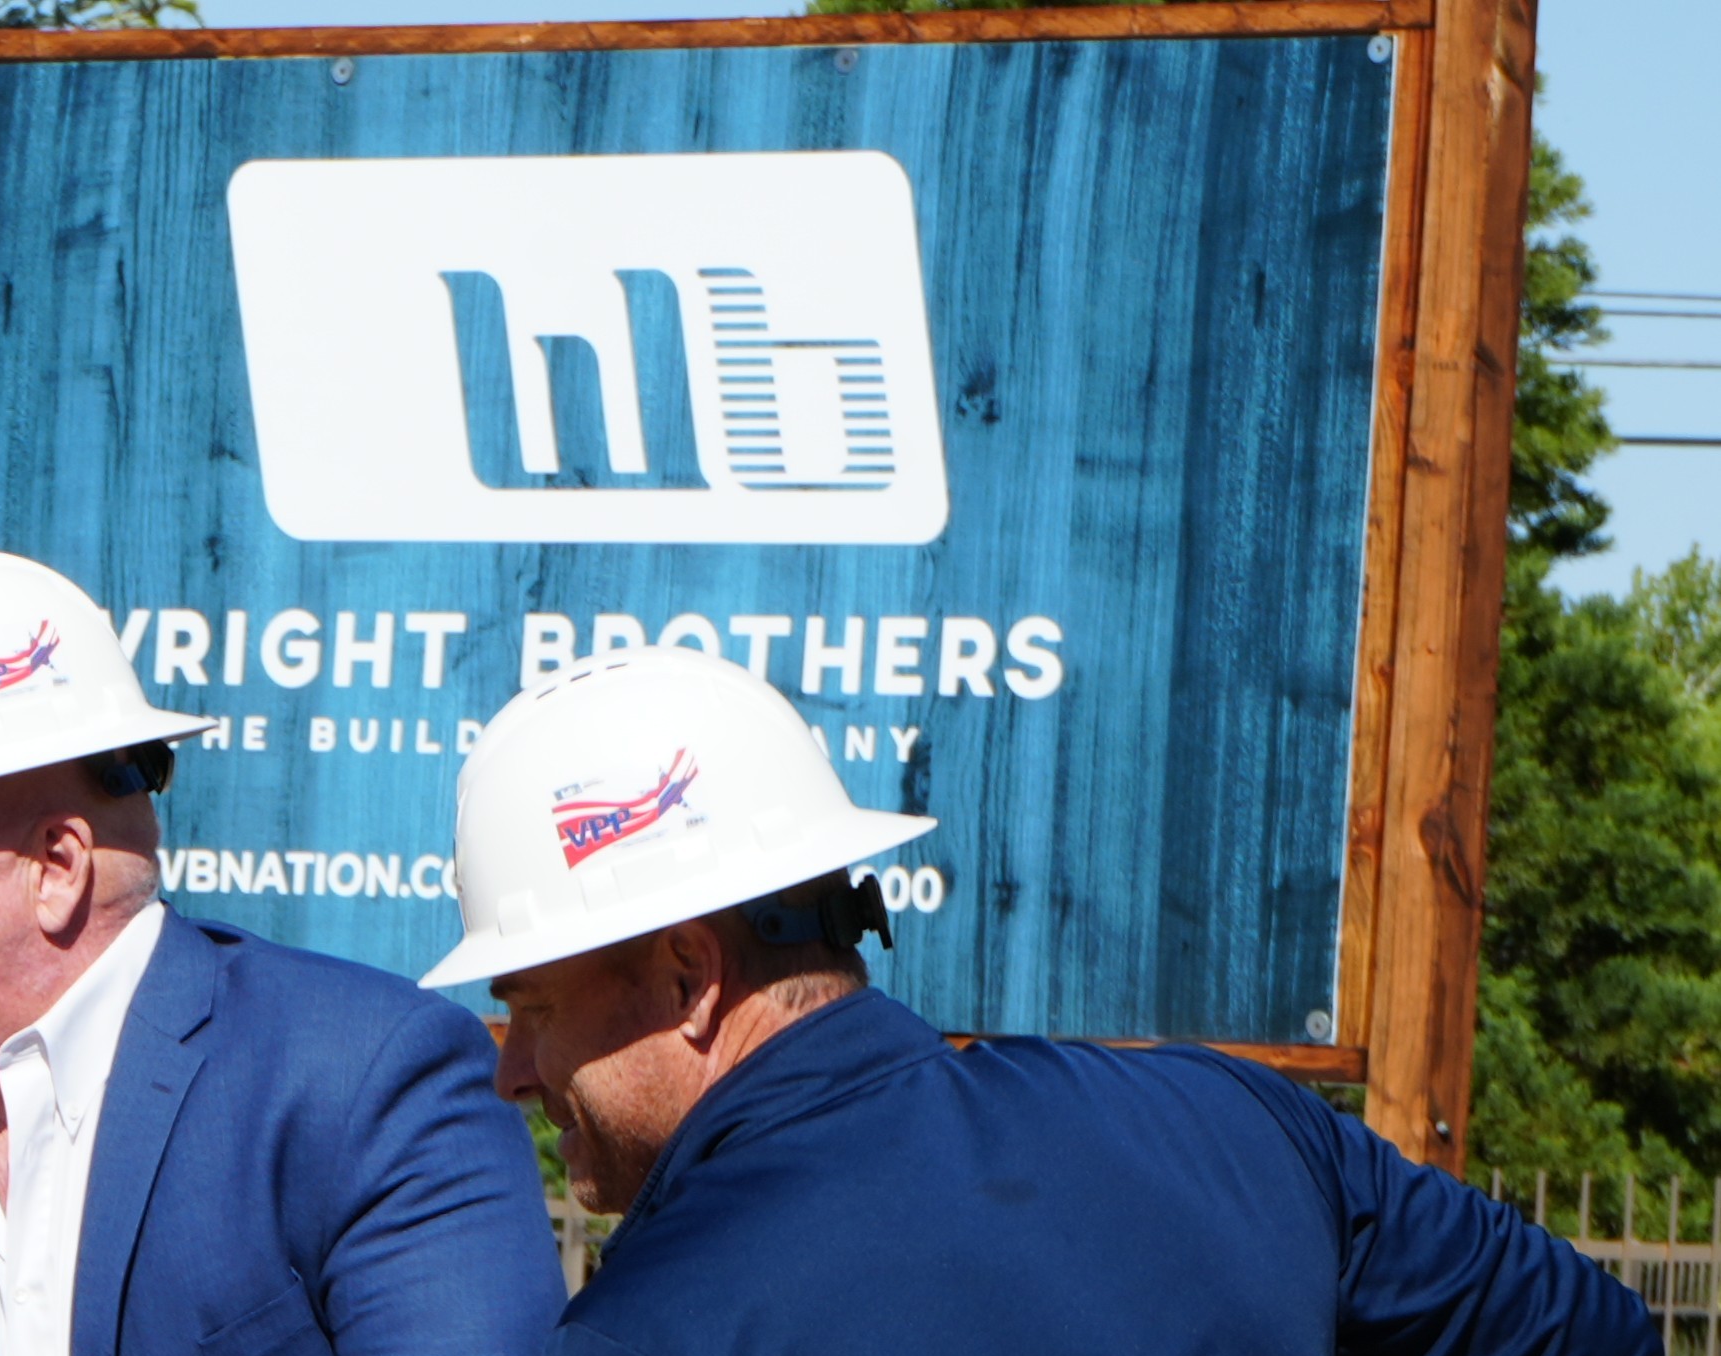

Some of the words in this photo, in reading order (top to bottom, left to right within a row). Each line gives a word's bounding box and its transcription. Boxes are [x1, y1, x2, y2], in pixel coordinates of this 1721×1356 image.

[170, 716, 269, 752] HE
[309, 716, 486, 755] BUILD
[564, 807, 632, 849] VPP
